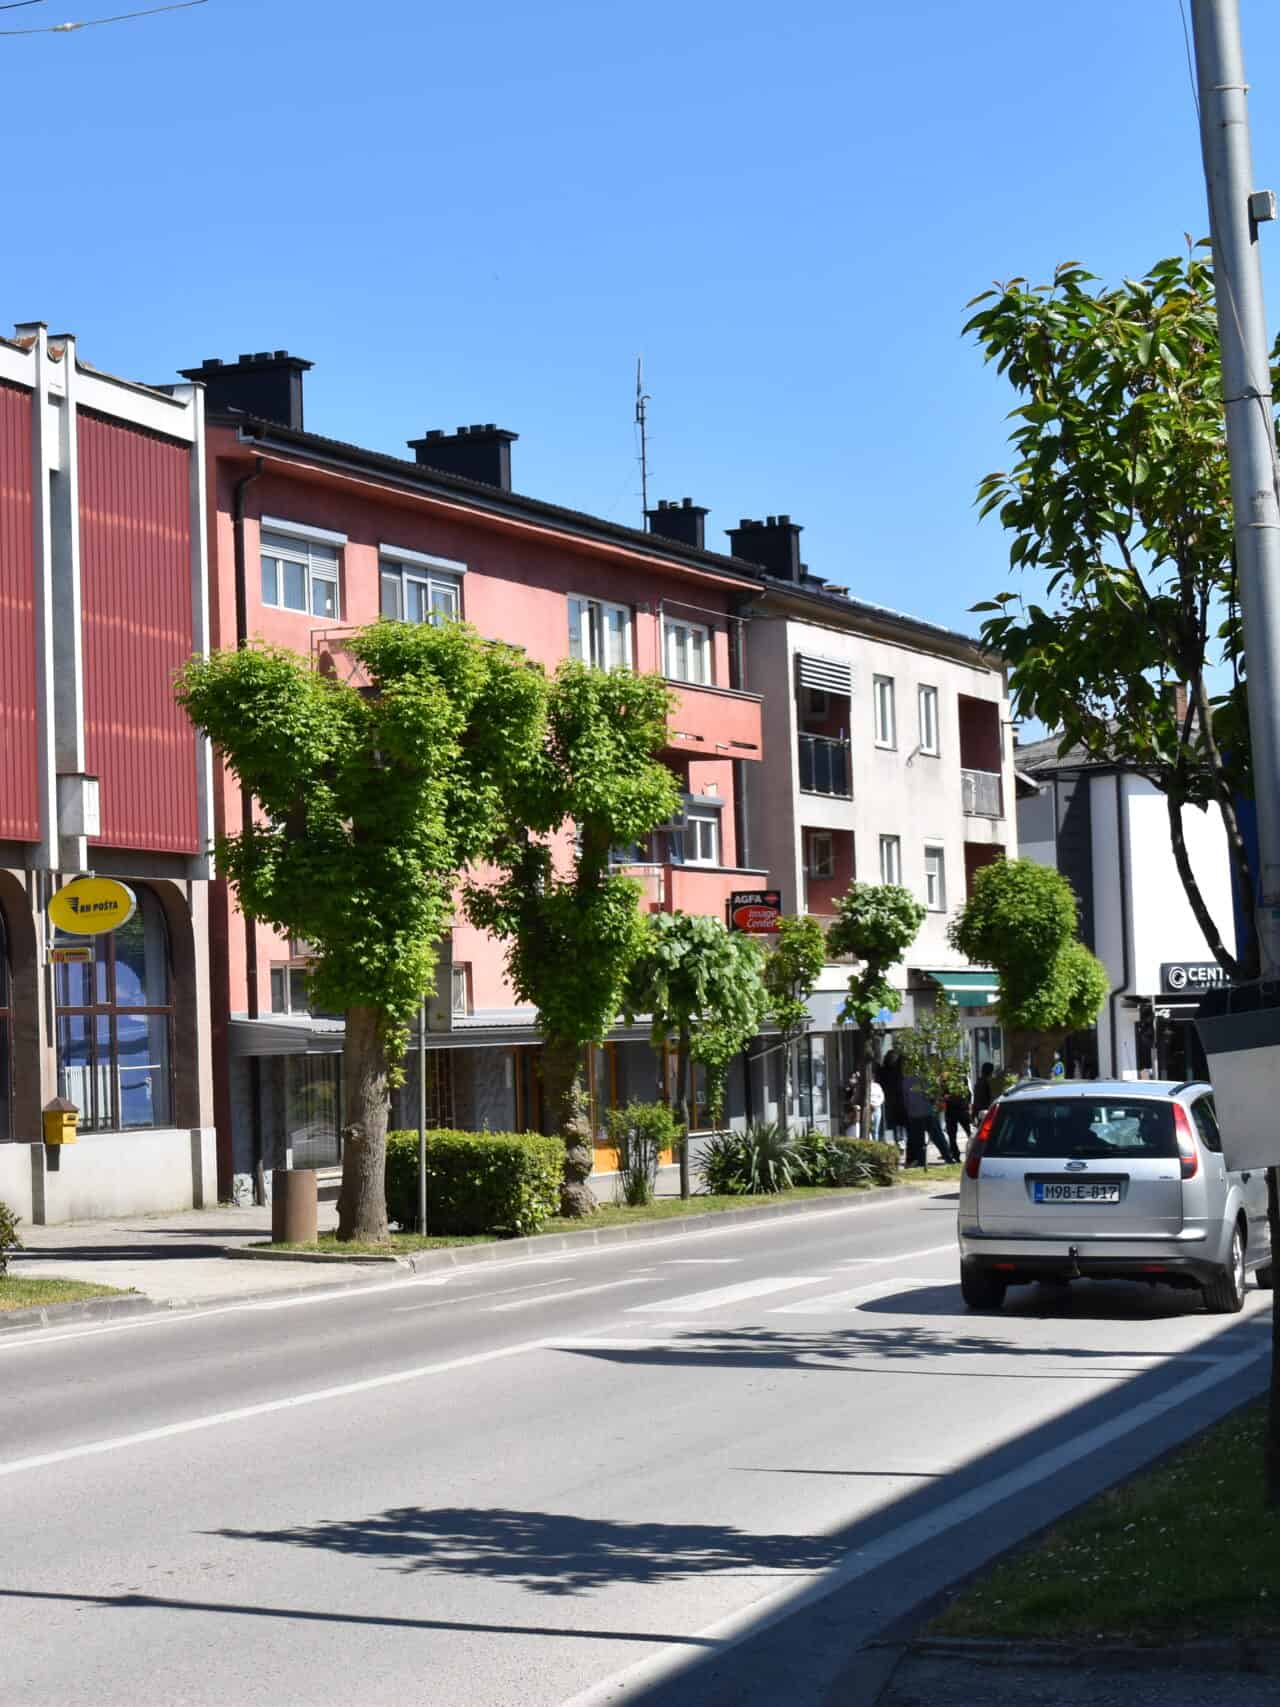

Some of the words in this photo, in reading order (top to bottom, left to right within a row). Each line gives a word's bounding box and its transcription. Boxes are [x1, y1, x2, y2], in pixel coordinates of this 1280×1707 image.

[734, 895, 762, 904] AGFA
[80, 904, 91, 912] BH
[93, 900, 119, 912] POŠTA
[748, 911, 777, 919] Image
[746, 918, 776, 928] Center
[1188, 967, 1230, 981] CENT
[1045, 1185, 1117, 1199] M98-E-817
